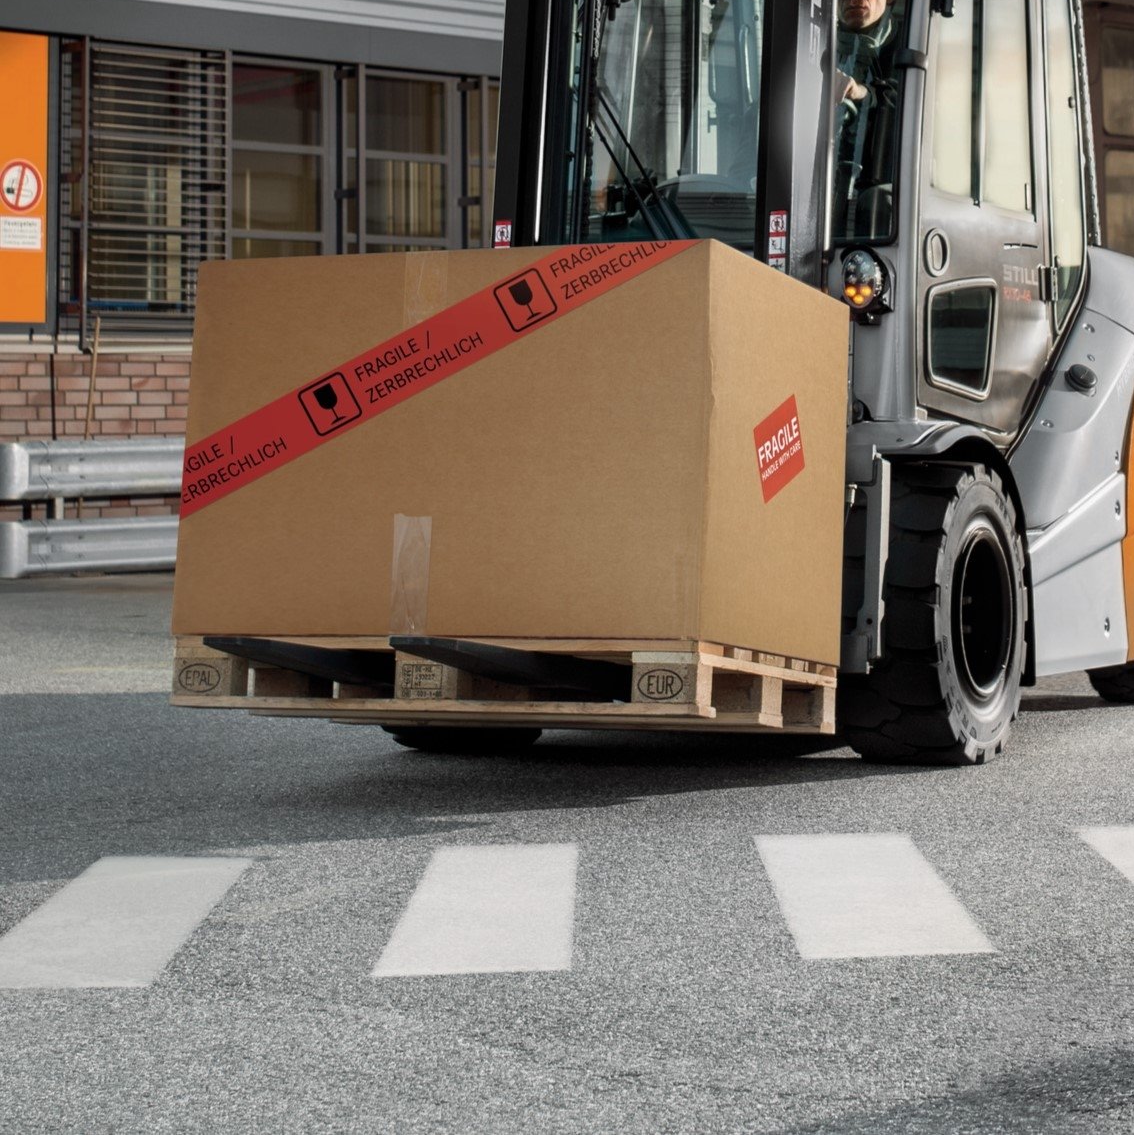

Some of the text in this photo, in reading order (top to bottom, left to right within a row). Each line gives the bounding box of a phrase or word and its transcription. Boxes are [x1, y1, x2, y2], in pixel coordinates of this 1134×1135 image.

[560, 241, 673, 300] ZERBRECHLI
[1002, 264, 1039, 286] STILL
[354, 337, 420, 382] FRAGILE
[364, 331, 484, 404] ZERBRECHLICH
[757, 416, 800, 469] FRAGILE
[761, 440, 801, 482] HANDLE WITH CARE
[185, 669, 215, 687] EPAL
[646, 674, 675, 695] EUR
